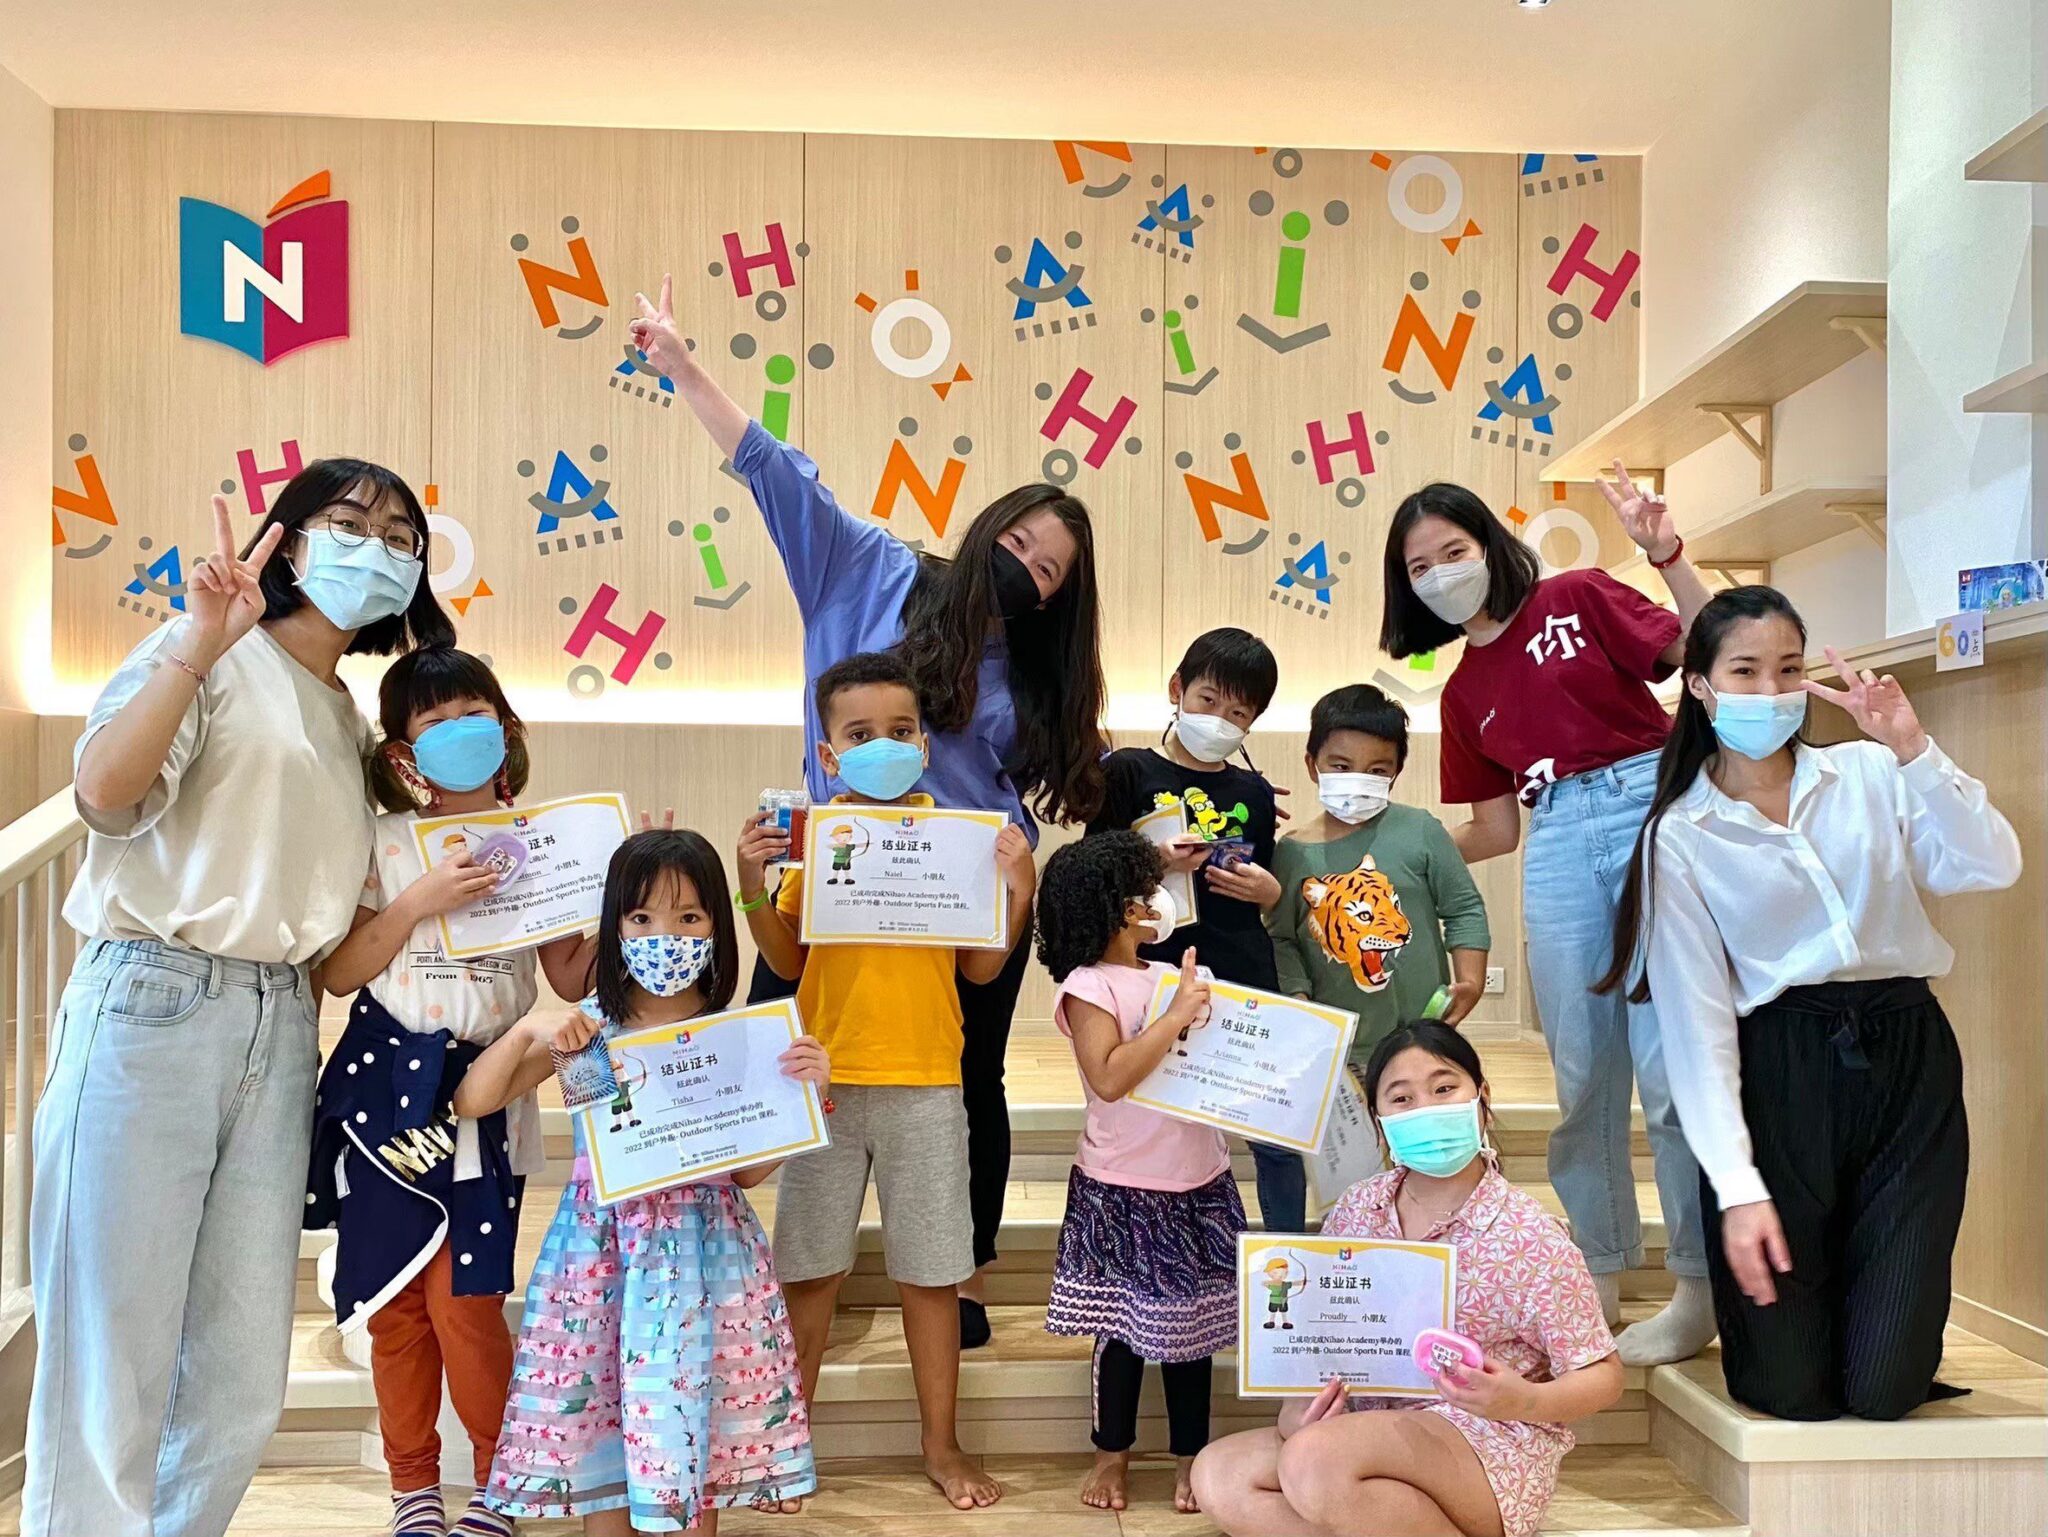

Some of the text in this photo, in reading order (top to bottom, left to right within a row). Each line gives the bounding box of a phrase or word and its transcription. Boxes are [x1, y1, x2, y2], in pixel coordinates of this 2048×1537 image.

[724, 224, 794, 297] H
[1547, 223, 1641, 323] H
[223, 239, 304, 323] N
[519, 238, 608, 329] N
[1383, 294, 1475, 390] N
[1040, 367, 1138, 469] H
[1307, 411, 1376, 484] H
[871, 439, 966, 538] N
[1184, 452, 1269, 542] N
[564, 583, 666, 686] H
[1525, 613, 1586, 666] 你
[881, 839, 932, 852] 结业证书
[922, 872, 946, 882] 小朋友
[469, 910, 487, 918] 2022
[523, 896, 554, 909] Outdoor
[555, 889, 580, 900] Sports
[580, 884, 596, 892] Fun
[884, 900, 912, 908] Outdoor
[914, 900, 937, 909] Sports
[938, 901, 951, 909] Fun
[425, 972, 494, 984] From 1965
[501, 962, 512, 971] USA
[1221, 1017, 1270, 1039] 结业证书
[660, 1053, 718, 1077] 结业证书
[671, 1083, 743, 1106] Tisha 小朋友
[1162, 1067, 1179, 1079] 2022
[1210, 1079, 1239, 1092] Outdoor
[1239, 1087, 1262, 1099] Sports
[1262, 1092, 1276, 1103] Fun
[624, 1143, 643, 1154] 2022
[679, 1125, 713, 1139] Outdoor
[714, 1119, 740, 1132] Sports
[741, 1115, 758, 1124] Fun
[1319, 1276, 1371, 1289] 结业证书
[1319, 1312, 1387, 1323] Proudly 小朋友
[1272, 1346, 1290, 1354] 2022
[1323, 1346, 1353, 1355] Outdoor
[1354, 1347, 1378, 1356] Sports
[1378, 1347, 1394, 1356] Fun
